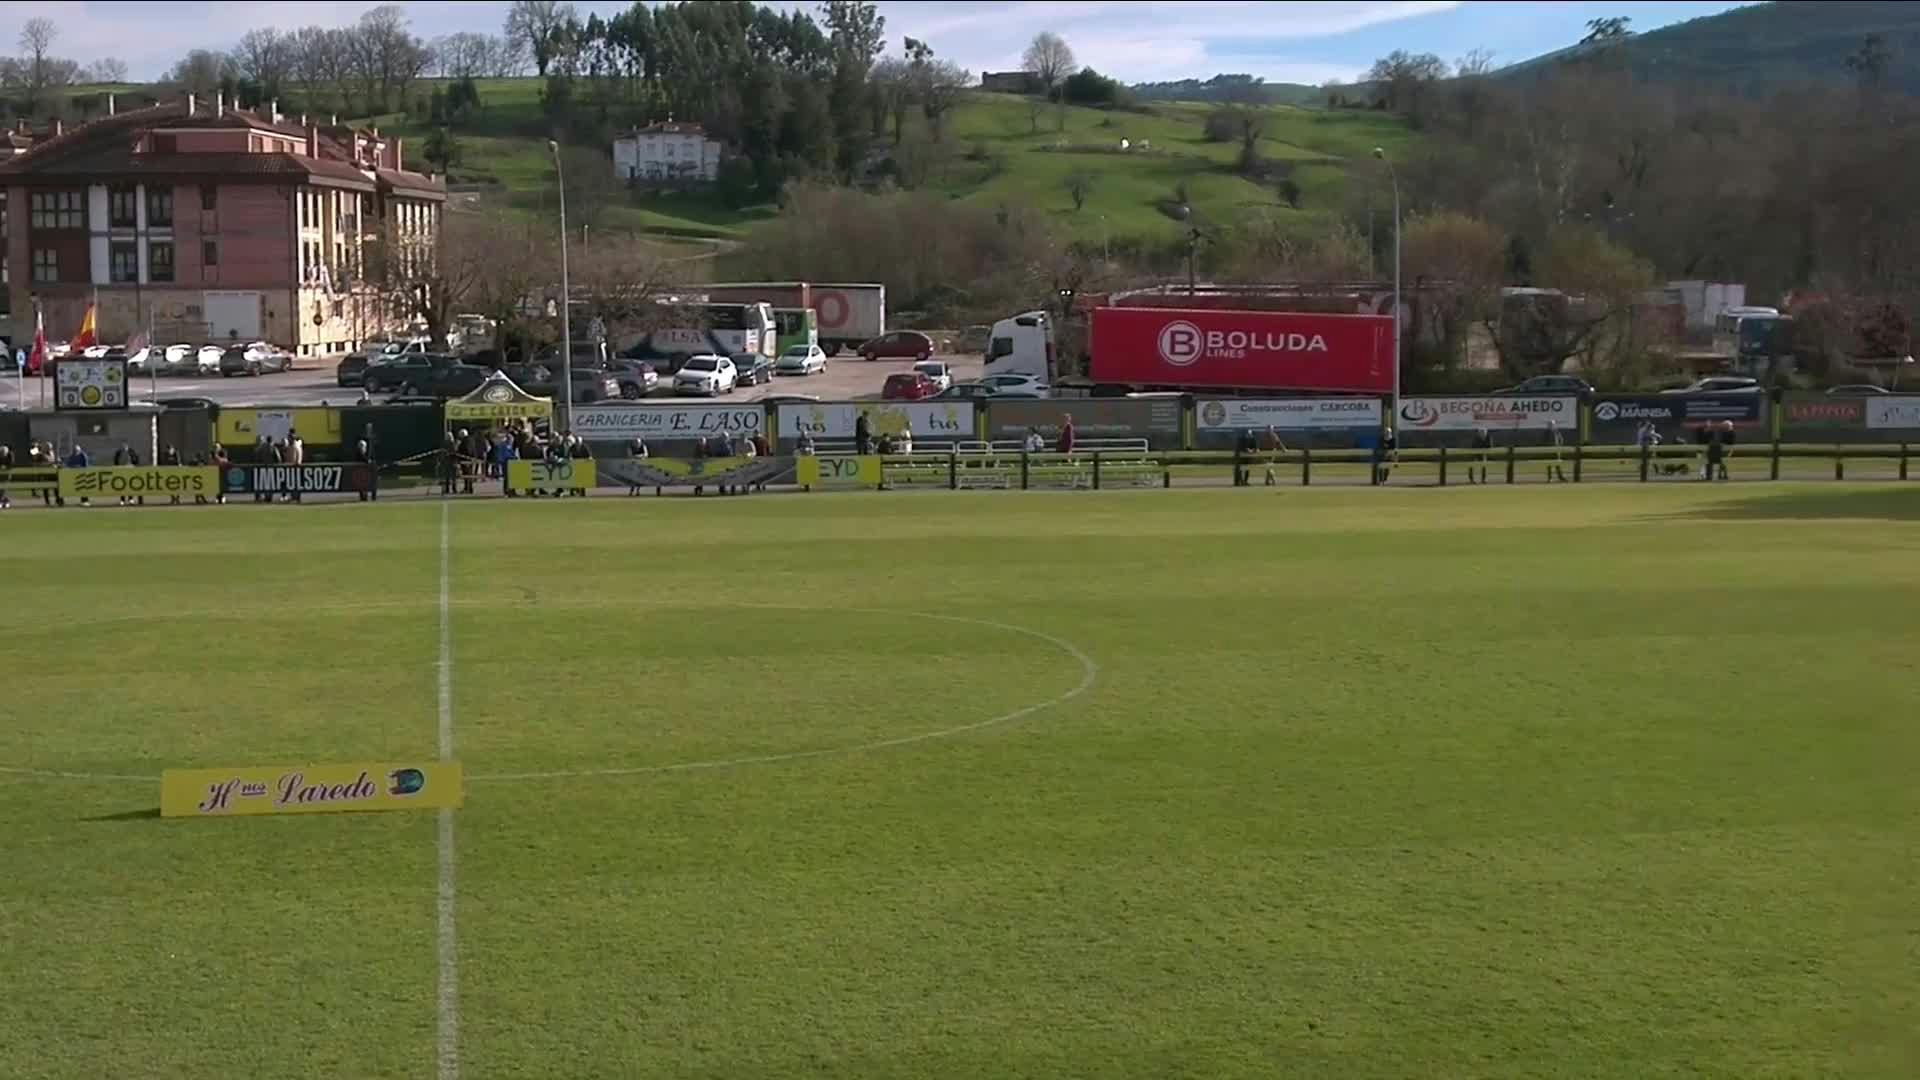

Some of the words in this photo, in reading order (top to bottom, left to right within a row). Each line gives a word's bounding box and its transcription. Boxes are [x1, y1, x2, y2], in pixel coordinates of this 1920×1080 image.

[1169, 330, 1196, 356] B
[1207, 331, 1328, 352] BOLUDA
[1207, 349, 1245, 359] LINES
[1440, 400, 1507, 413] BEGOÑA
[1510, 400, 1563, 413] AHEDO
[1619, 407, 1673, 418] MAINSA
[576, 413, 662, 427] CARNICERIA
[670, 412, 692, 431] E.
[699, 411, 760, 432] LASO
[253, 466, 342, 490] IMPULSO27
[531, 462, 573, 481] EYD
[818, 459, 859, 477] EYD
[98, 471, 204, 491] Footters
[273, 771, 377, 804] Laredo
